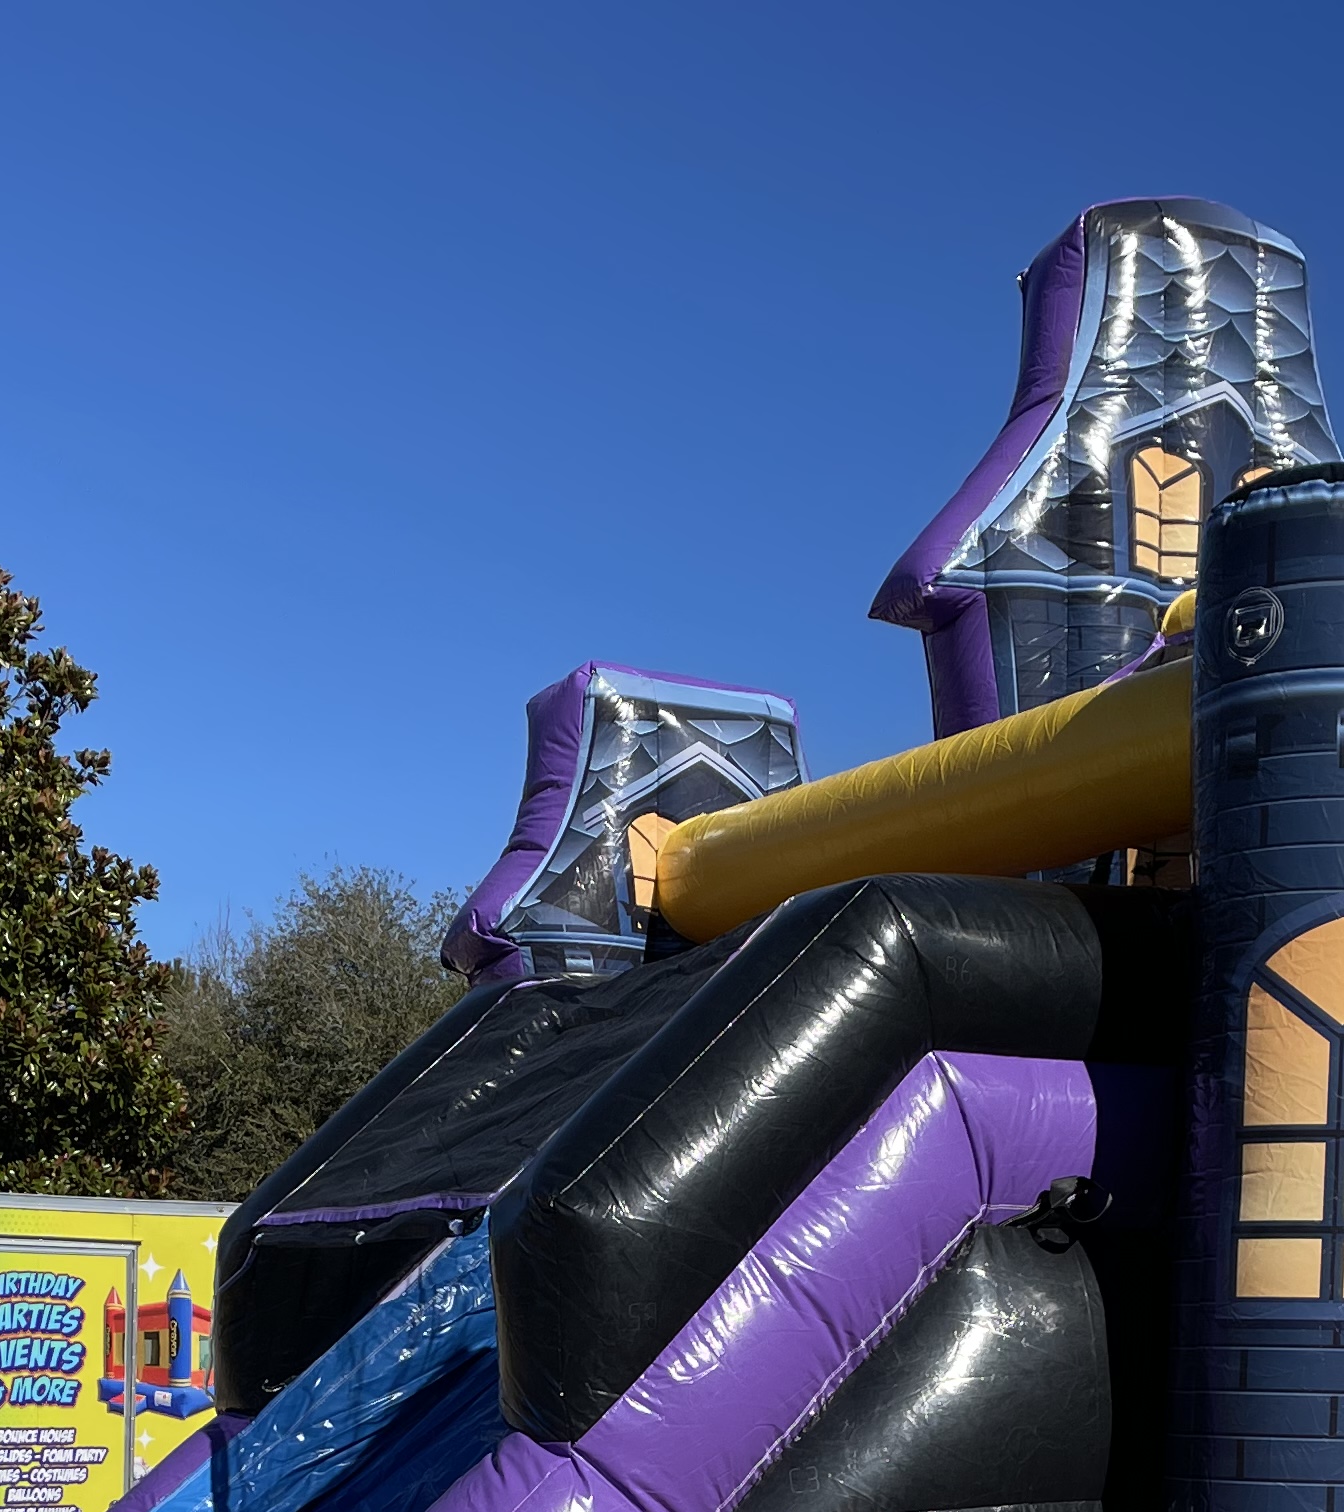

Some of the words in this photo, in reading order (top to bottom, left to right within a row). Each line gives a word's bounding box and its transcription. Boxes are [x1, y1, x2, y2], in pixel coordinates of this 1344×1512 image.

[9, 1376, 79, 1404] MORE
[39, 1429, 75, 1443] HOUSE
[42, 1448, 74, 1463] FOAM
[74, 1448, 108, 1462] PARTY
[30, 1468, 88, 1482] COSTUMES
[6, 1487, 63, 1502] BALLOONS
